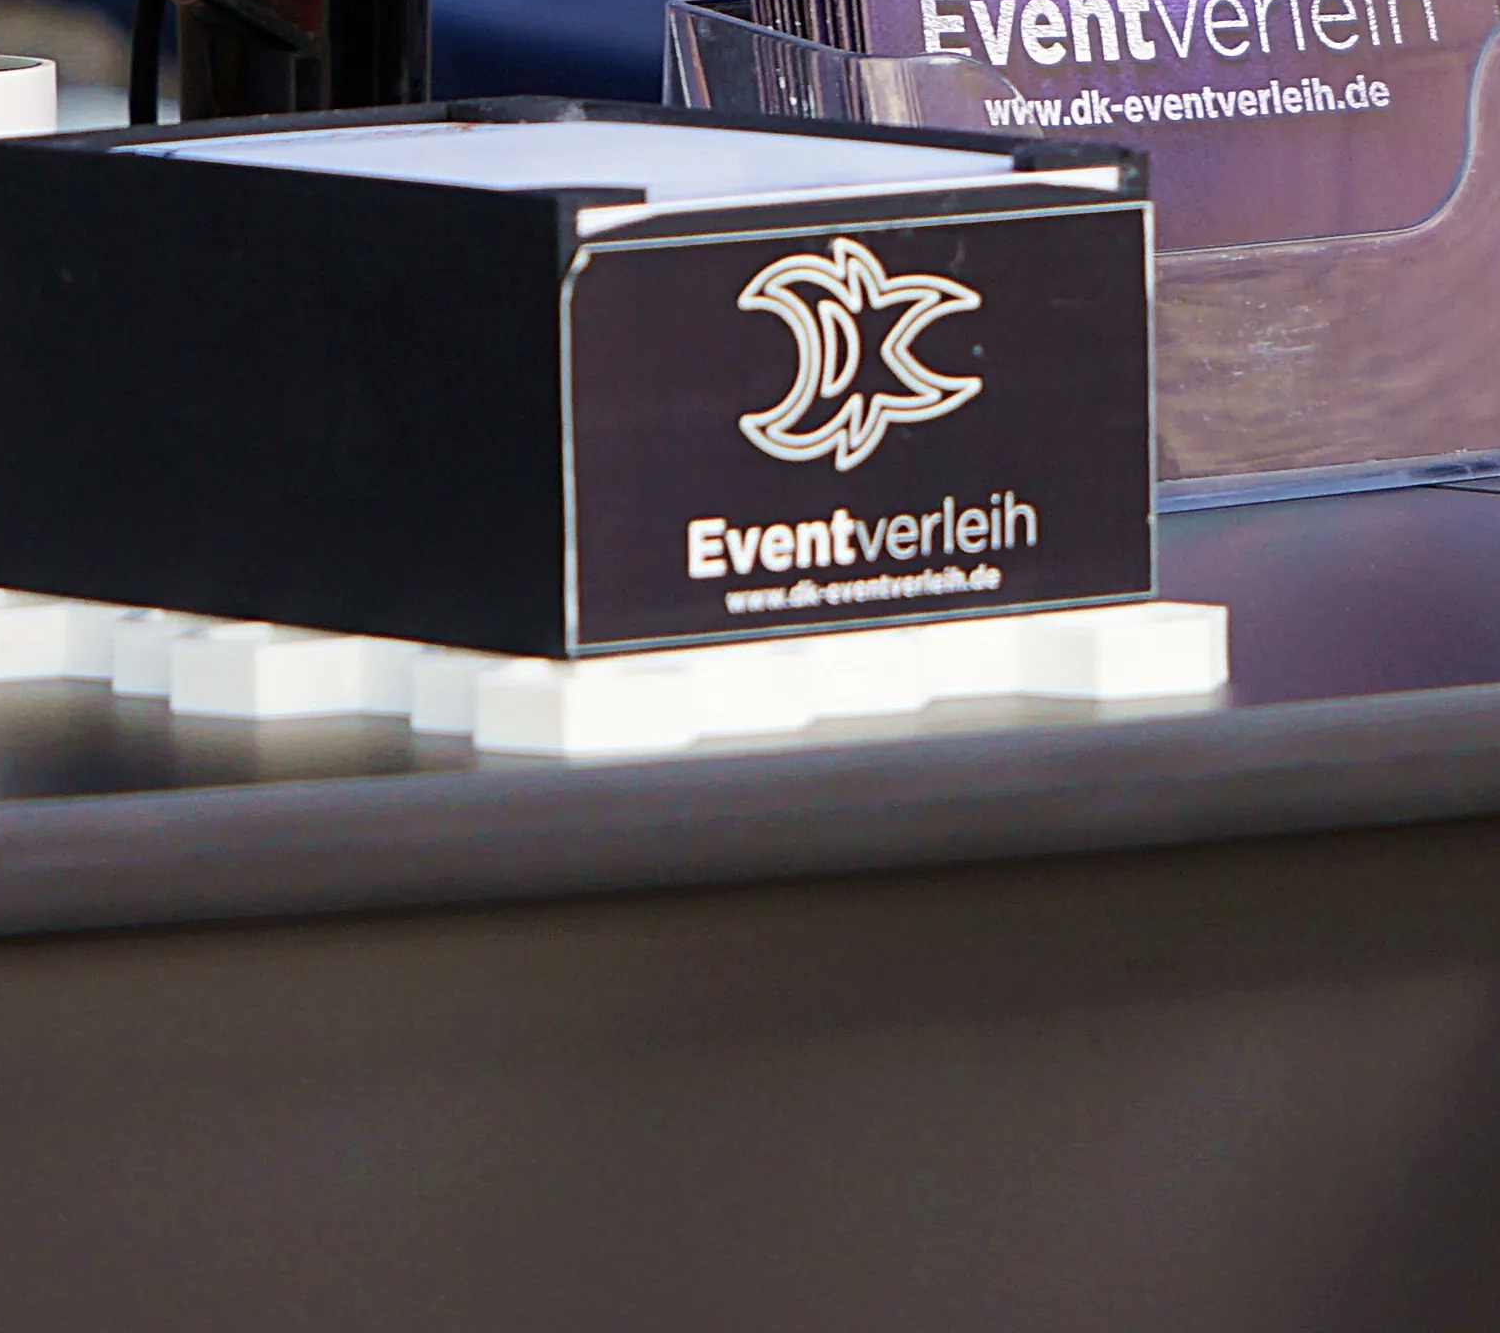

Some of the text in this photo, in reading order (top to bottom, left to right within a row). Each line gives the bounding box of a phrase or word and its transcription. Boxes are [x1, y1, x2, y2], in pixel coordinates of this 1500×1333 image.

[984, 73, 1392, 130] www.dk-eventverleih.de
[687, 489, 1039, 580] Eventverleih
[725, 563, 1004, 614] www.dk-eventverleih.de
